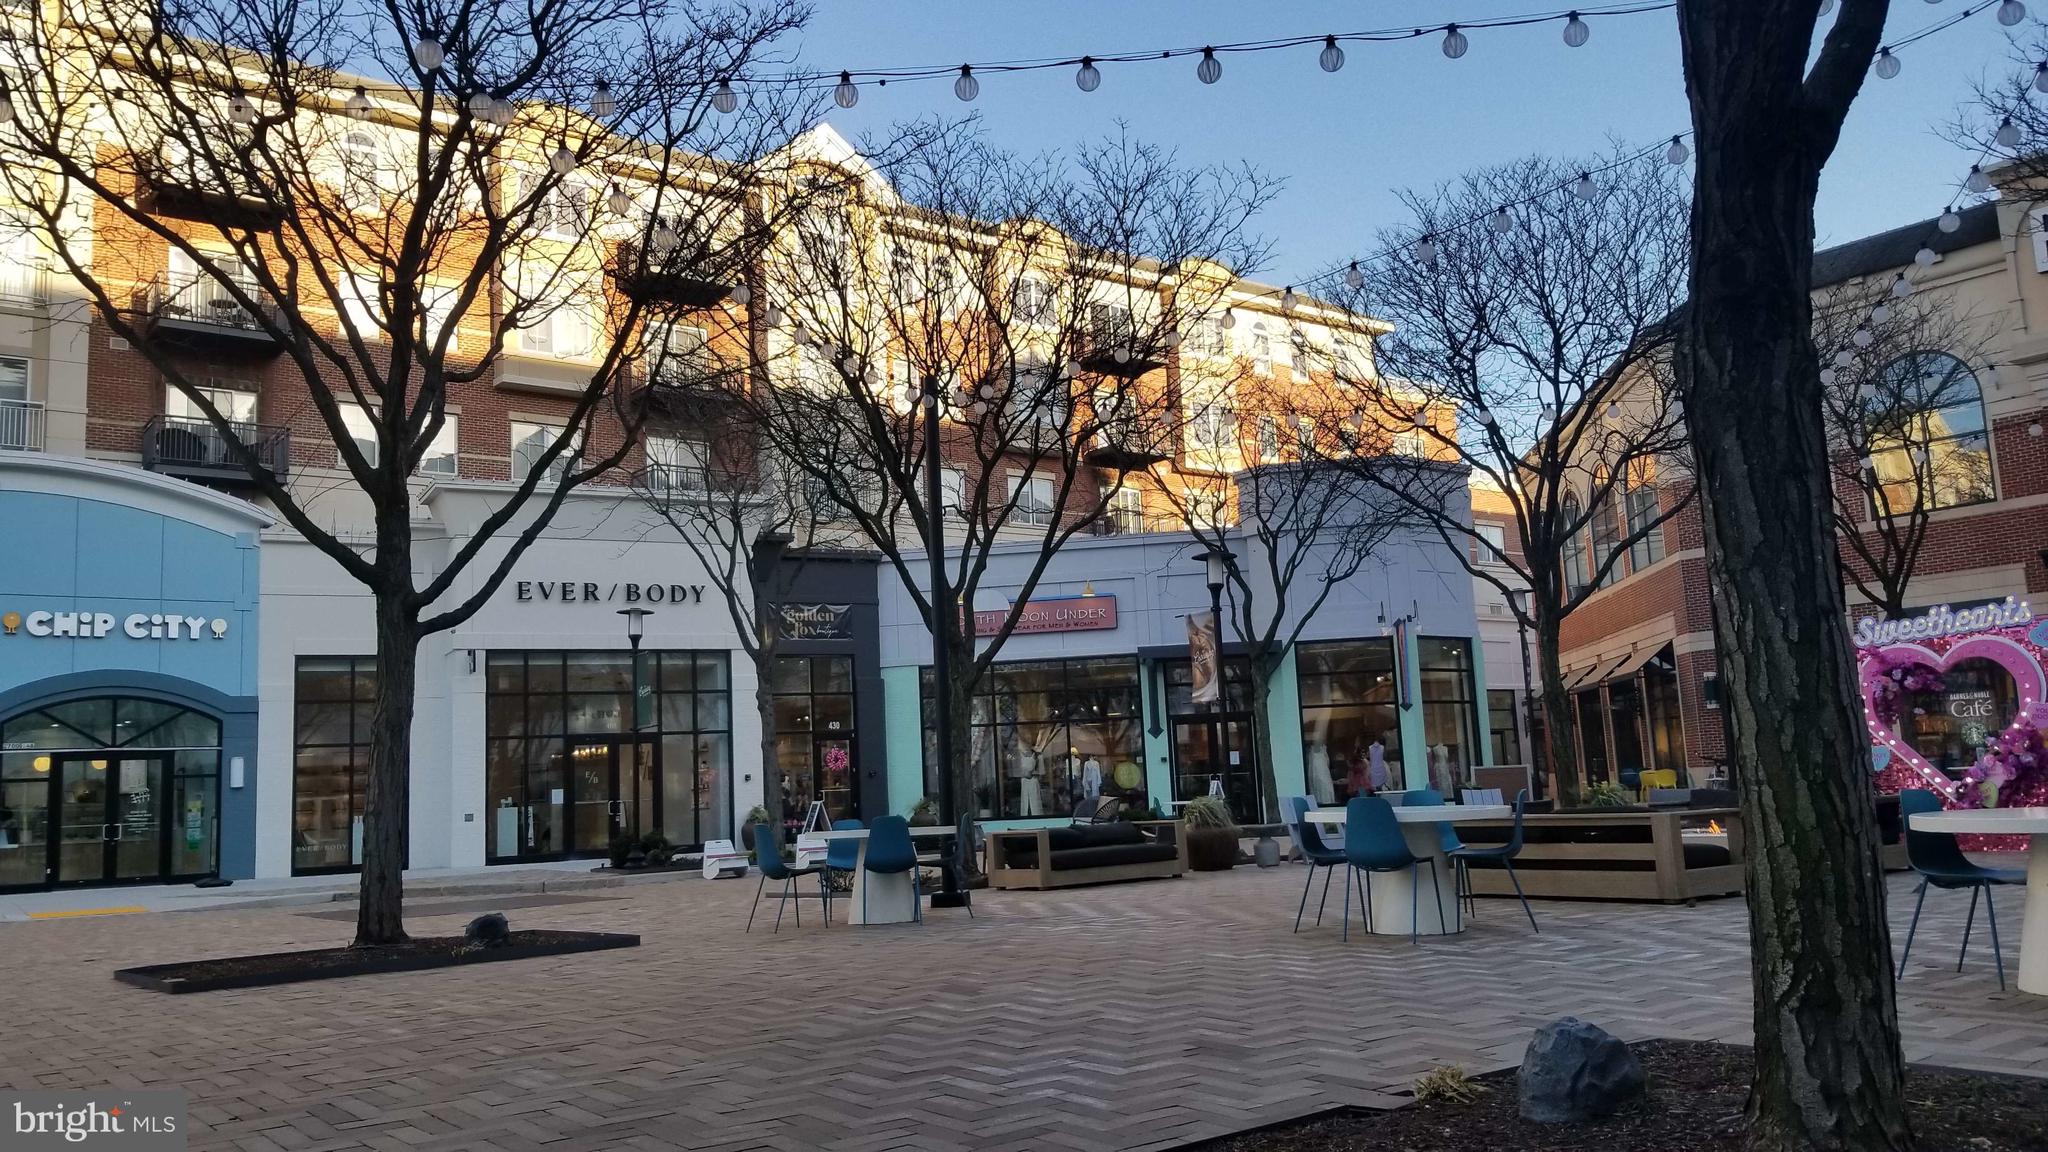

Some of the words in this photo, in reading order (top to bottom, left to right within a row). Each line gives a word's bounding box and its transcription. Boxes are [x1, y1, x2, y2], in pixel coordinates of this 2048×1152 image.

[1056, 608, 1107, 620] UNDER
[1853, 594, 2034, 649] Sweethearts
[1951, 699, 1993, 718] Café
[828, 722, 840, 730] 430
